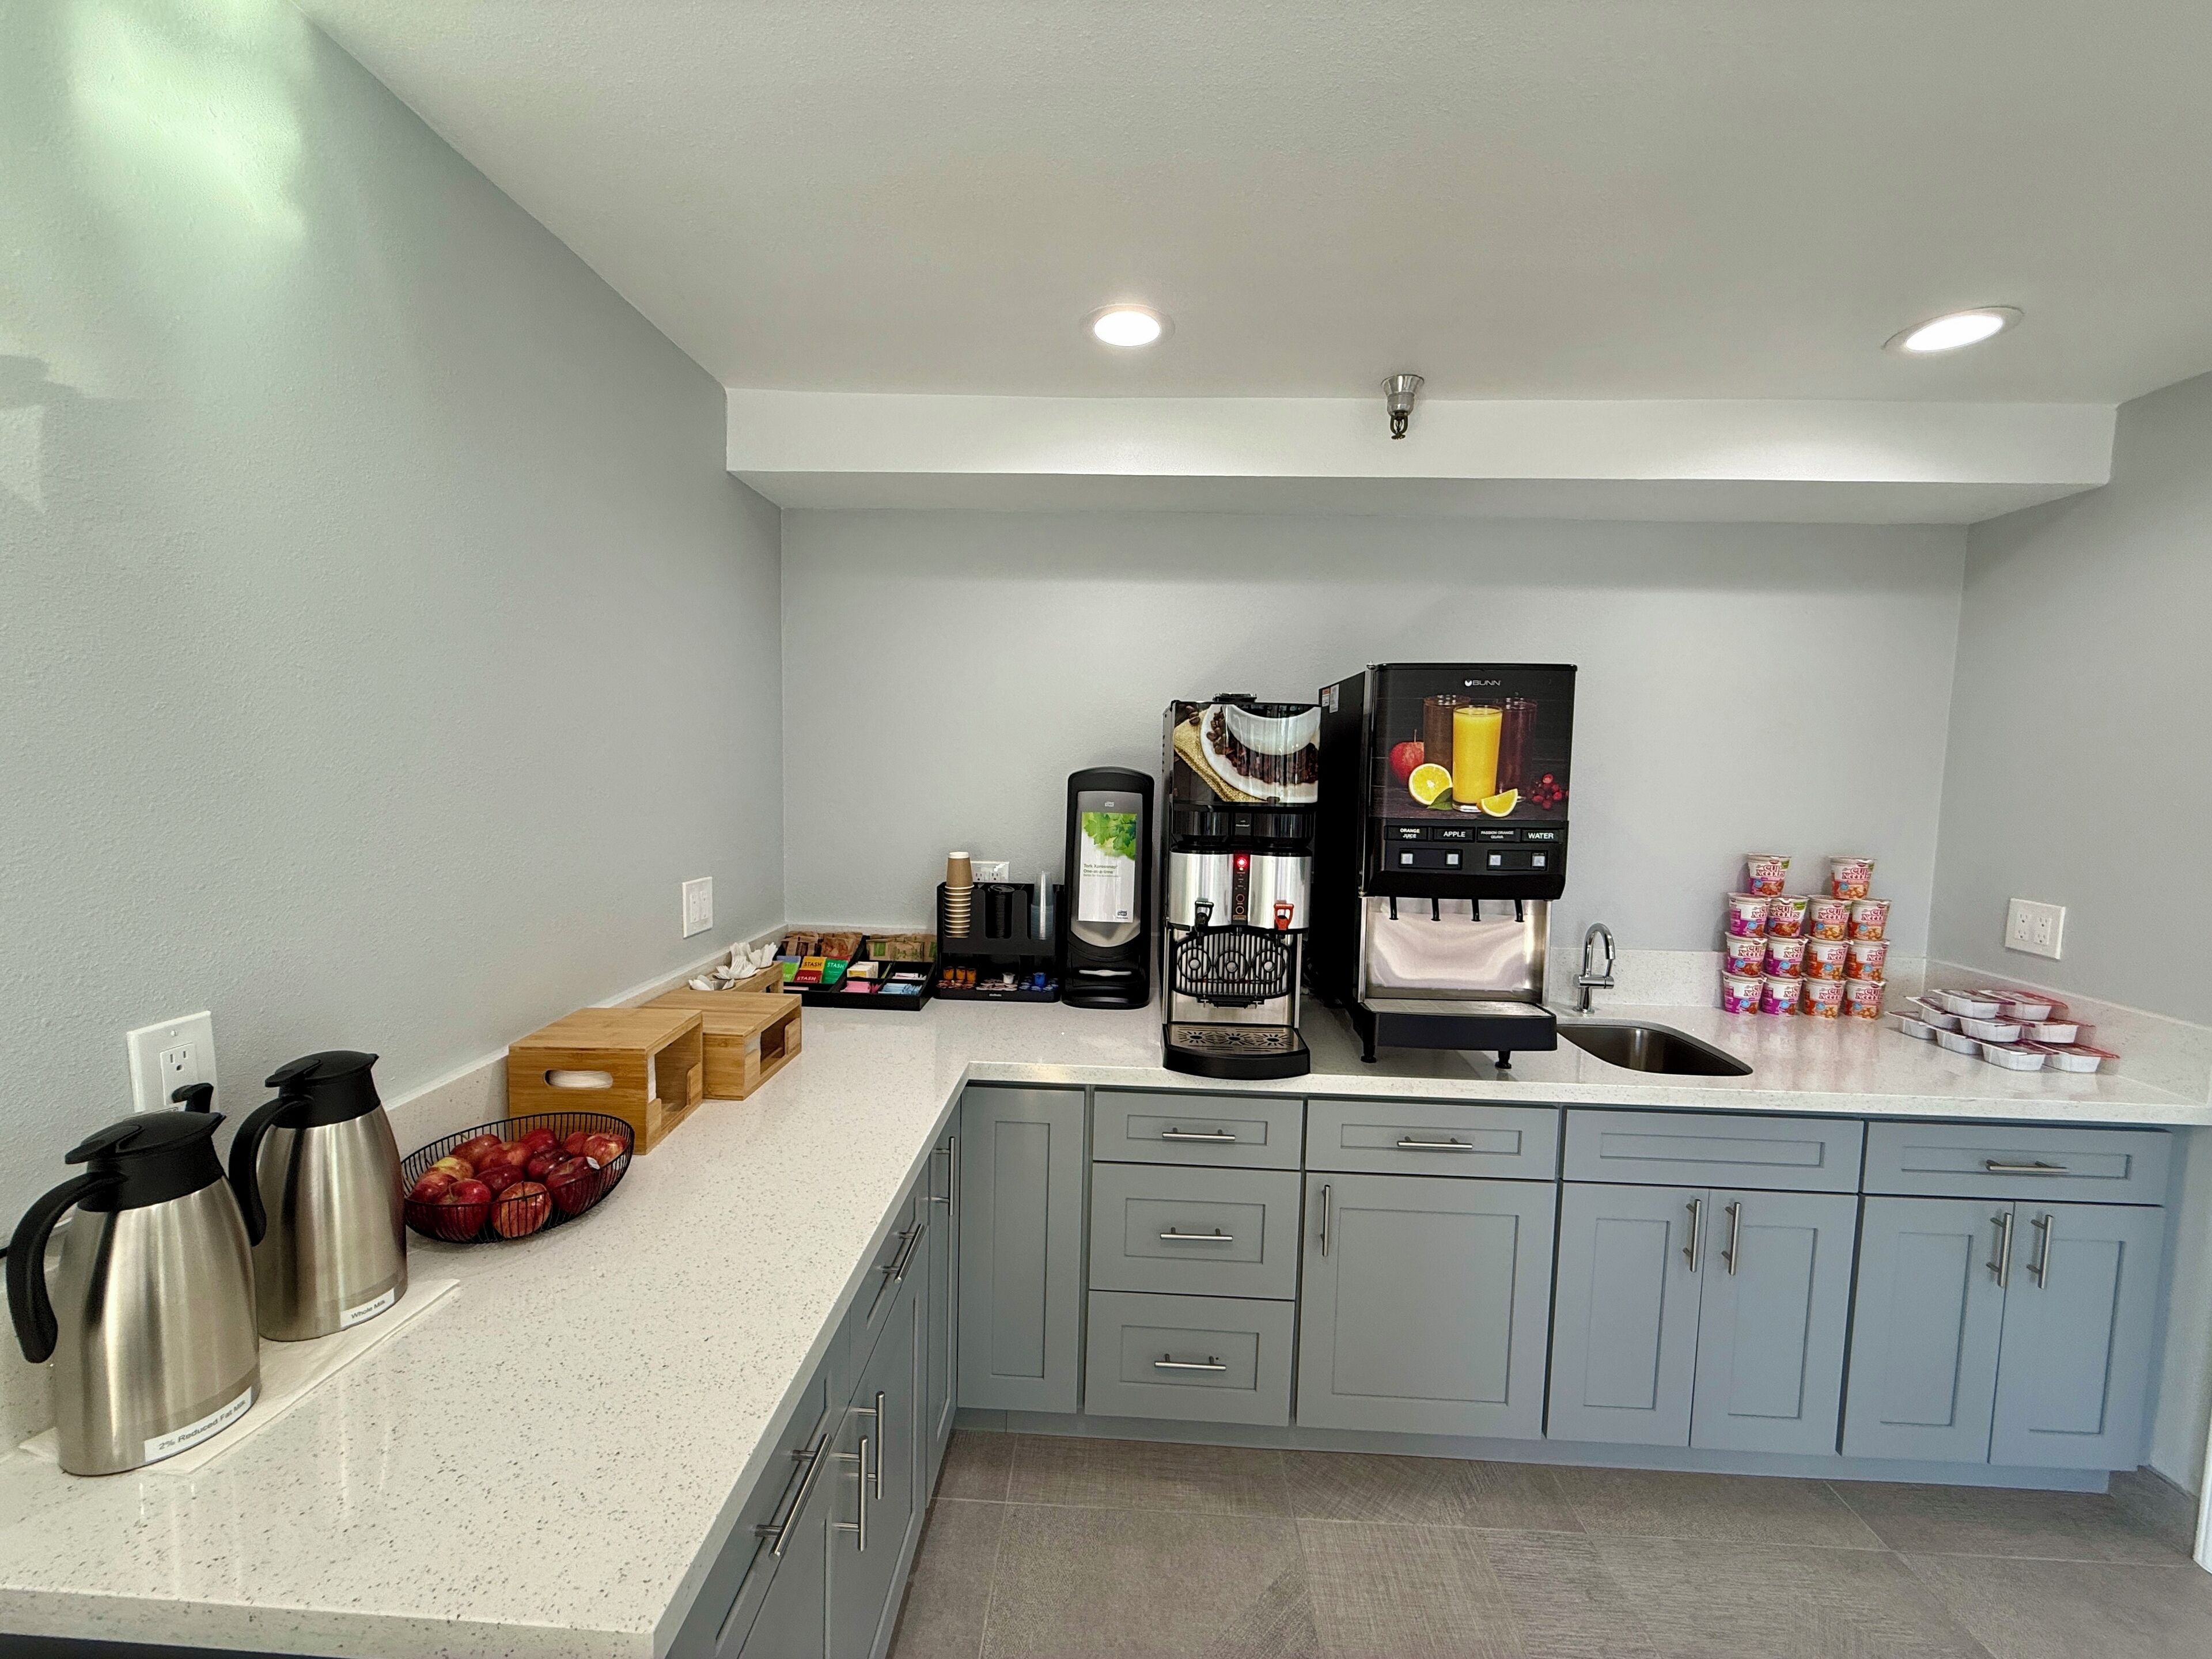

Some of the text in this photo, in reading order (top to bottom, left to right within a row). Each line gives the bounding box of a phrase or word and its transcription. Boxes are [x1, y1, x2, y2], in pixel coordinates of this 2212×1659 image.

[351, 1307, 373, 1319] Whole
[158, 1440, 176, 1450] 2%
[178, 1419, 218, 1442] Reduced
[219, 1409, 233, 1421] Fat
